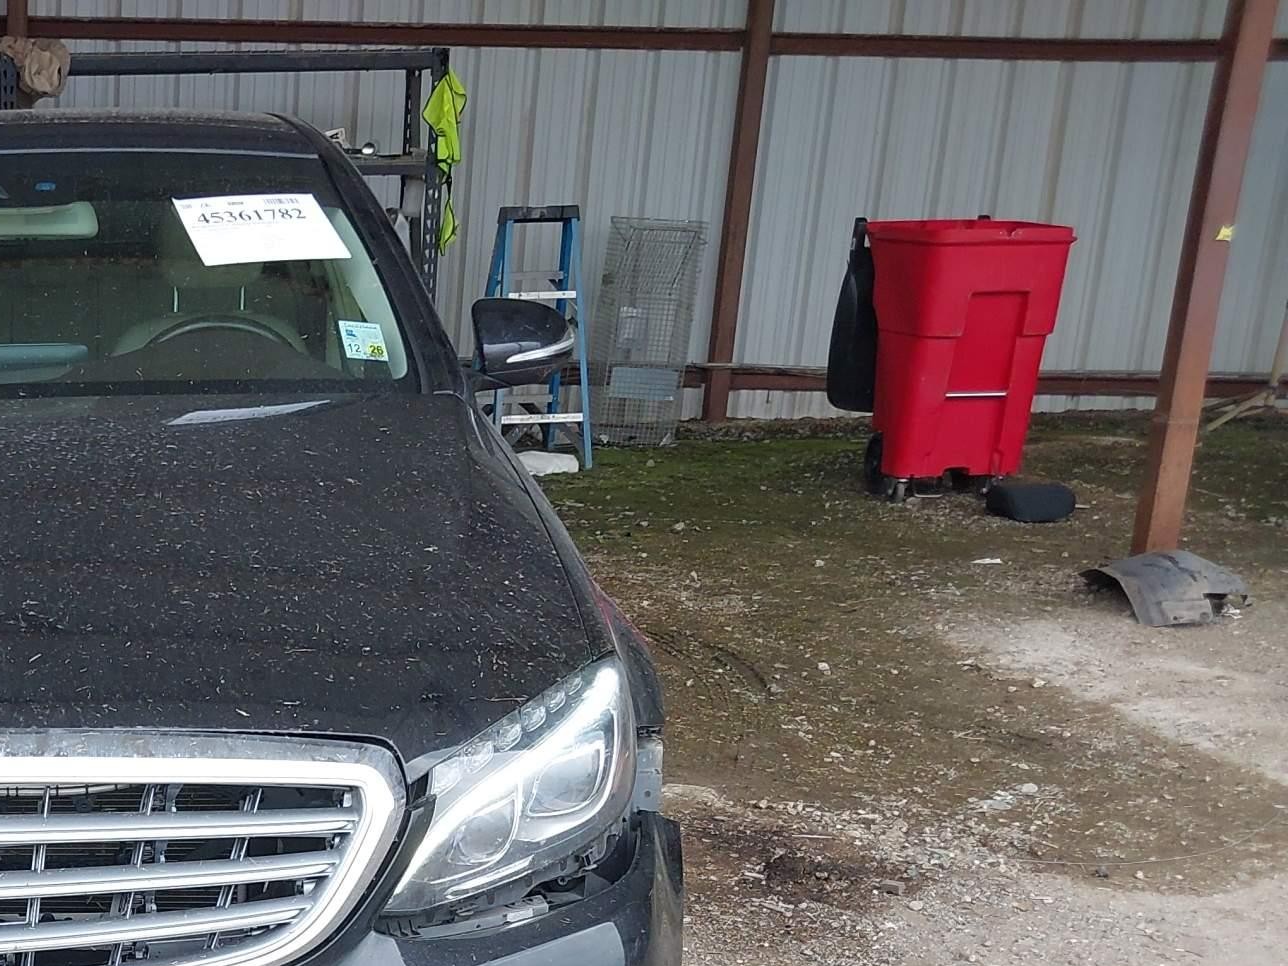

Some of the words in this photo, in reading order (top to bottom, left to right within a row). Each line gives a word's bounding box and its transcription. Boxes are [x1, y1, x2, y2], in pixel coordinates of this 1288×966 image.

[197, 207, 307, 225] 45361782
[347, 343, 362, 353] 12
[369, 344, 384, 356] 26
